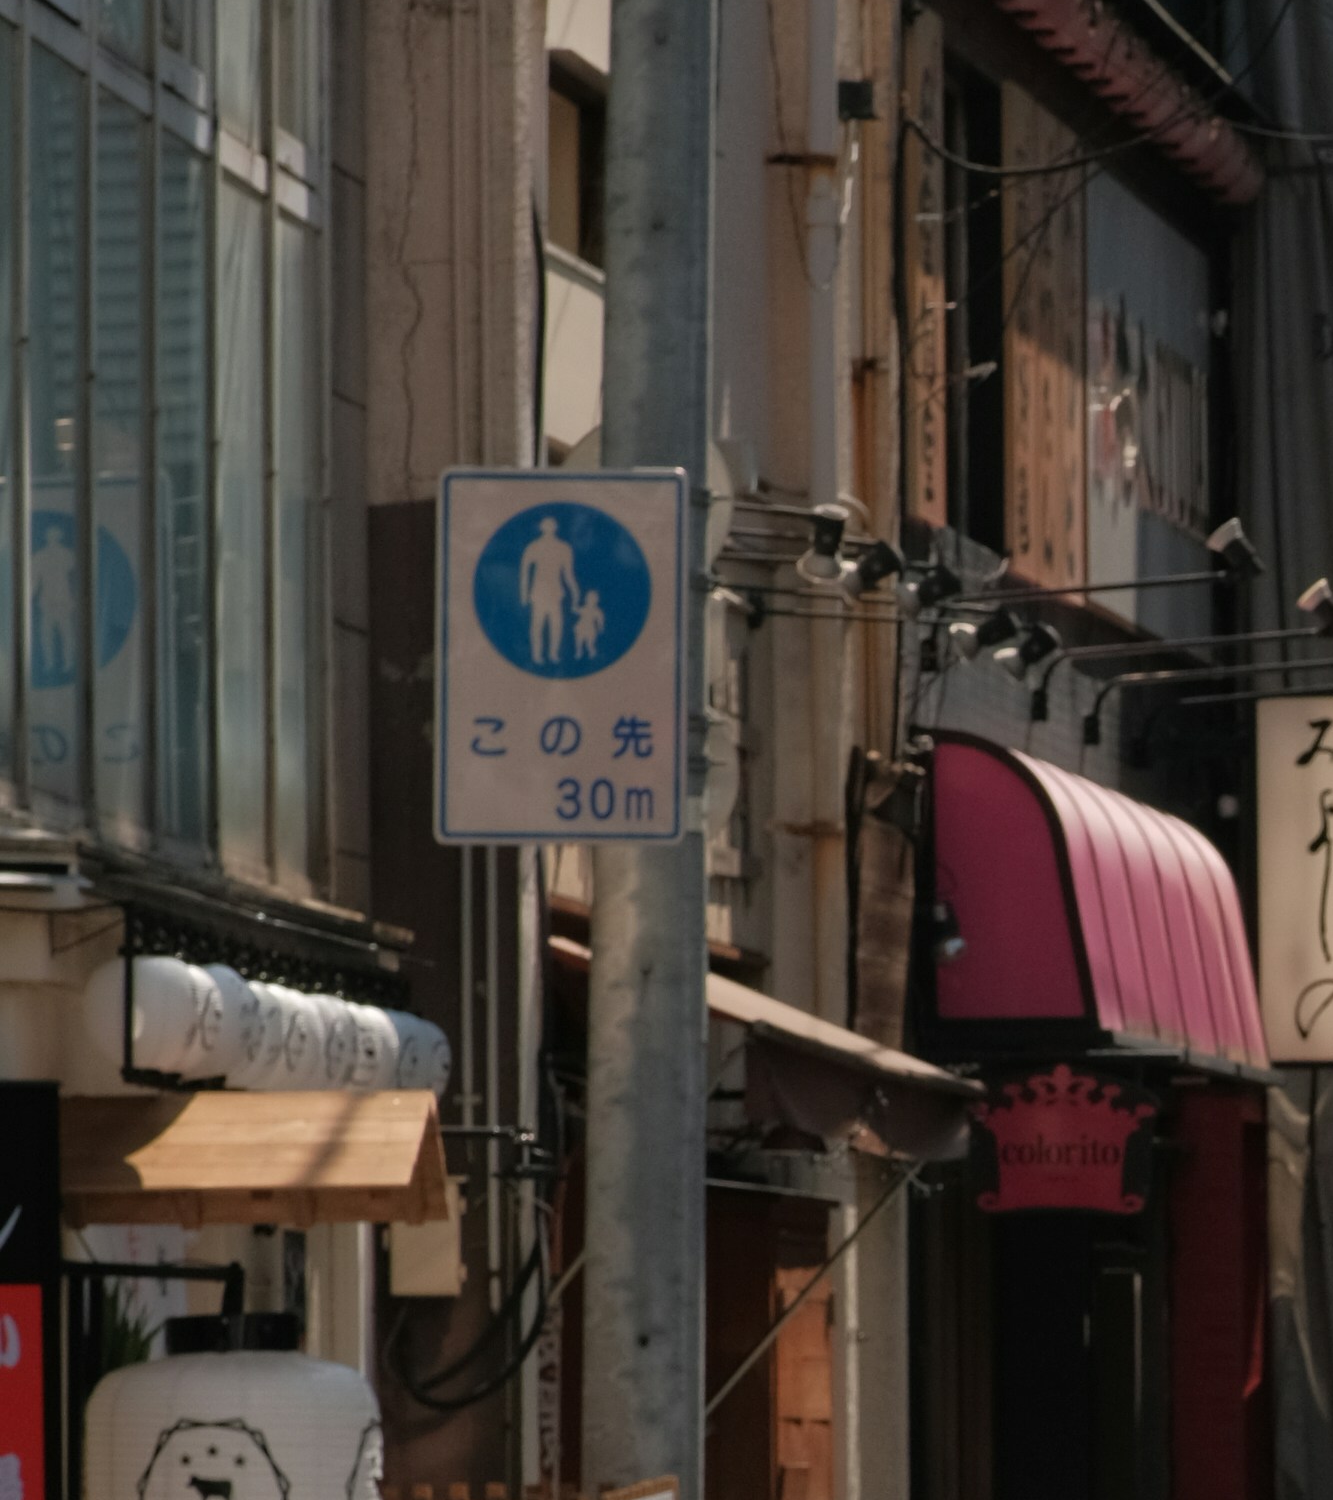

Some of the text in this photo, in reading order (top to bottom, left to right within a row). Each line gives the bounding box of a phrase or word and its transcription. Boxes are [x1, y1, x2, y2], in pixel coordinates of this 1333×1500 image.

[470, 715, 655, 759] この先
[555, 777, 655, 823] 30m
[1001, 1134, 1121, 1166] colorito
